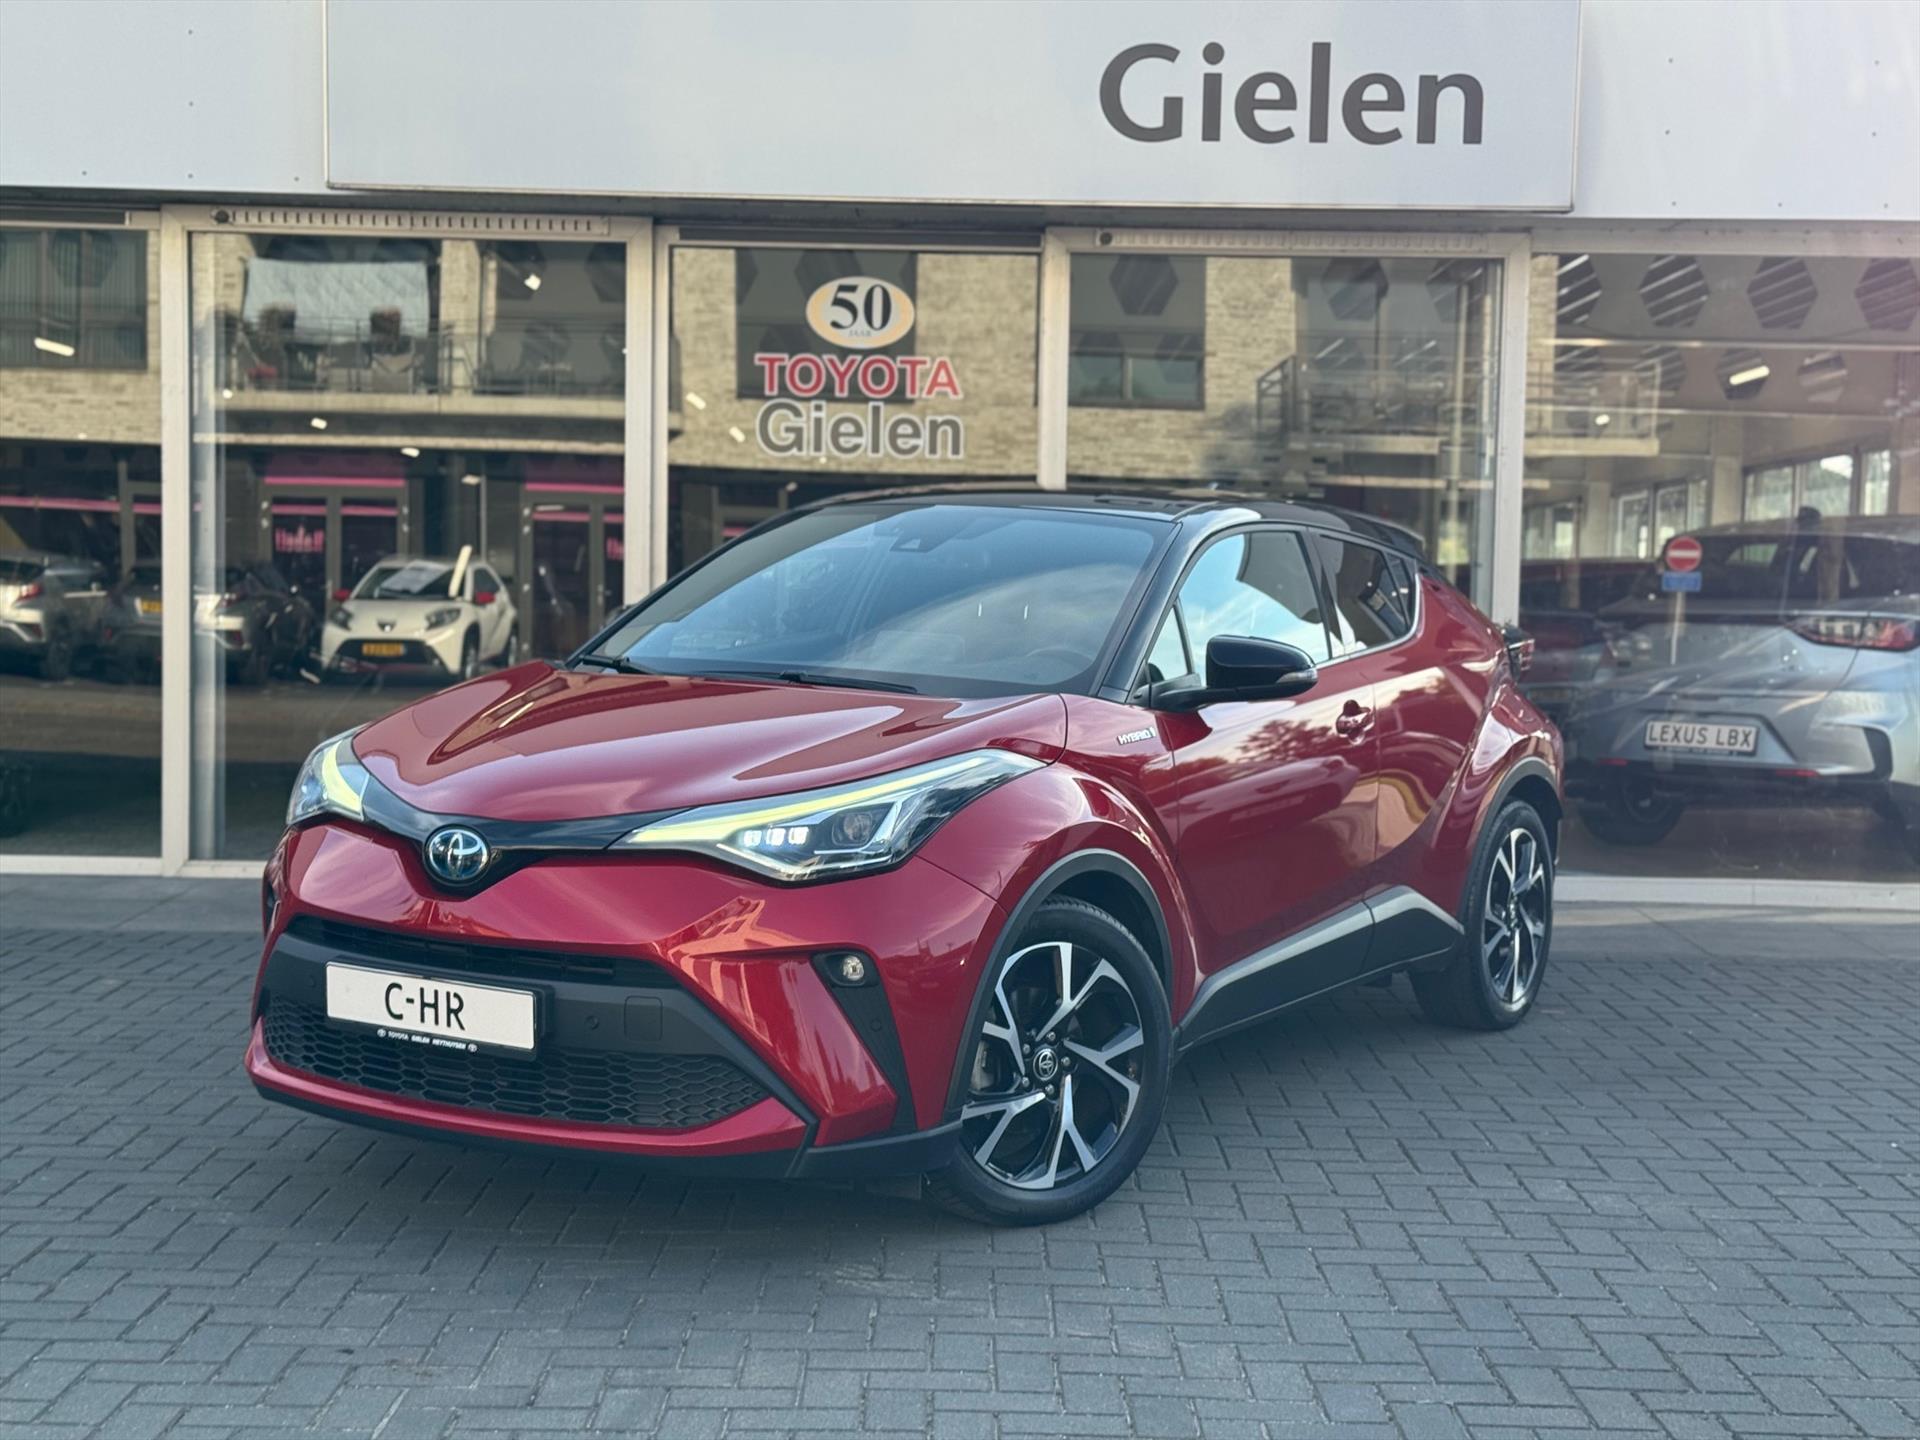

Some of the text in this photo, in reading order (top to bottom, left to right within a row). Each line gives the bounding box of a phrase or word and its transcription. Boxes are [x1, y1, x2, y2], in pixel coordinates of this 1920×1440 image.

[1100, 41, 1484, 146] Gielen
[830, 283, 892, 331] 50
[755, 354, 962, 398] TOYOTA
[757, 399, 963, 457] Gielen
[1117, 729, 1151, 744] HYBRID
[1648, 724, 1752, 748] LEXUS LBX
[384, 982, 466, 1031] C-HR
